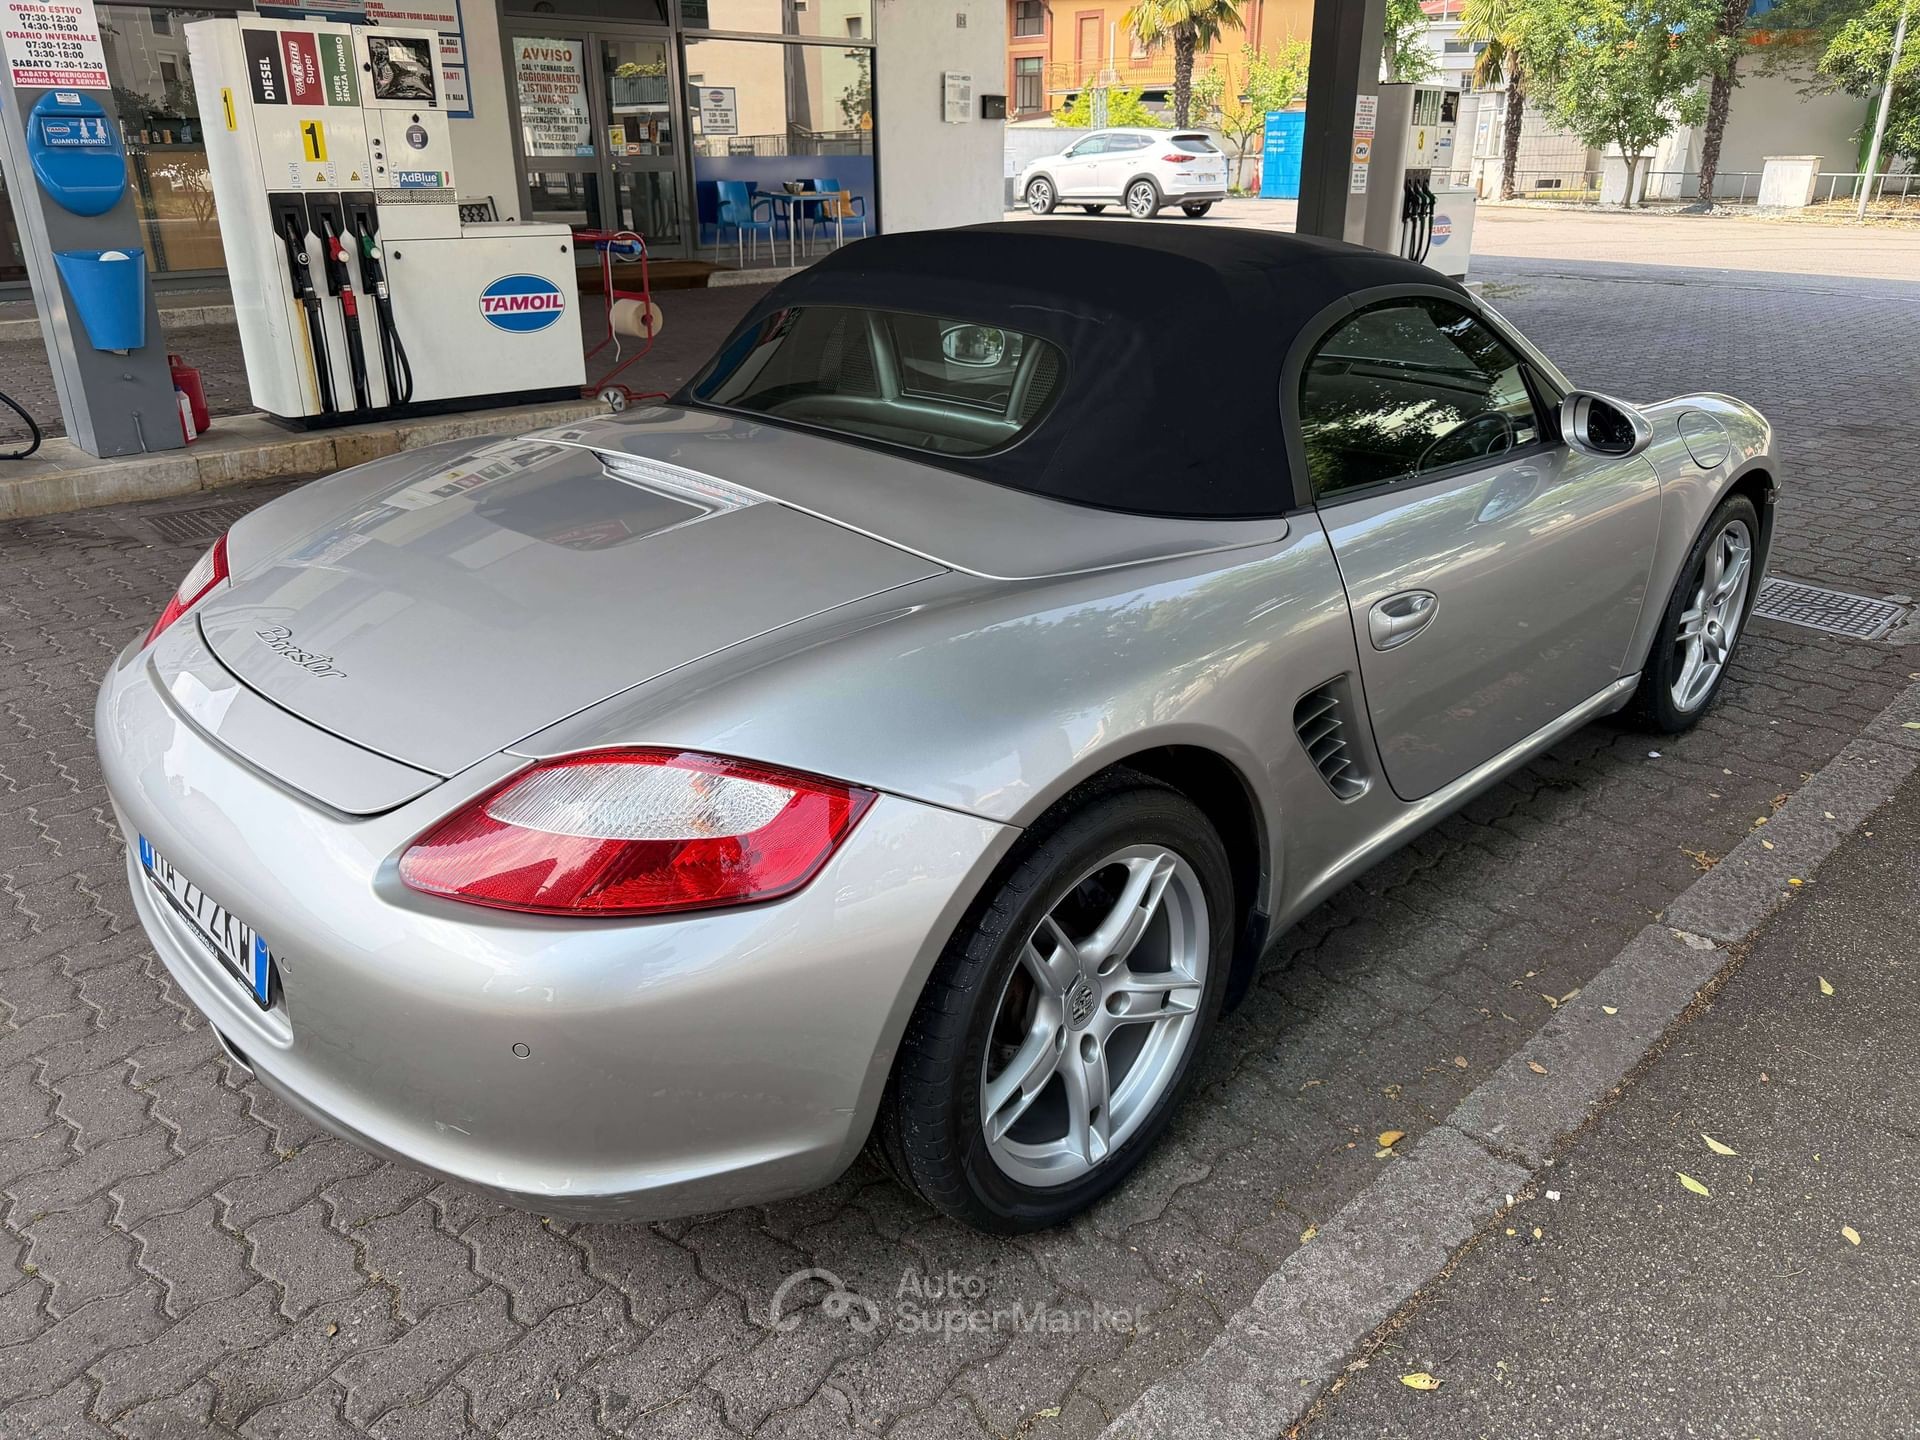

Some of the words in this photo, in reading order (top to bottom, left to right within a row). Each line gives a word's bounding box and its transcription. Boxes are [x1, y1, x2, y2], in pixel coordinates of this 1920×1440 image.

[9, 4, 46, 13] ORARIO
[48, 5, 82, 14] ESTIVO
[19, 13, 76, 23] 07:30-12:30
[21, 22, 78, 32] 14:30-19:00
[6, 31, 42, 40] ORARIO
[45, 32, 97, 42] INVERNALE
[25, 41, 82, 50] 07:30-12:30
[28, 50, 84, 59] 13:30-18:00
[335, 36, 347, 72] PIOMBO
[522, 47, 573, 62] AVVISO
[12, 59, 52, 68] SABATO
[54, 60, 103, 70] 7:30-12:30
[304, 54, 315, 84] Super
[521, 63, 532, 71] DAL
[49, 71, 94, 79] POMERIGGIO
[259, 56, 276, 100] DIESEL
[518, 71, 581, 84] AGGIORNAMENTO
[76, 78, 106, 86] SERVICE
[333, 75, 343, 102] SUPER
[342, 74, 351, 102] SENZA
[523, 83, 553, 94] LISTINO
[554, 84, 579, 94] PREZZI
[223, 90, 233, 129] 1
[305, 123, 320, 159] 1
[1417, 131, 1425, 150] 3
[1356, 146, 1368, 155] DKV
[400, 172, 438, 183] AdBlue
[1432, 225, 1452, 235] AMOIL
[481, 294, 564, 313] TAMOIL
[254, 624, 347, 678] Boxster
